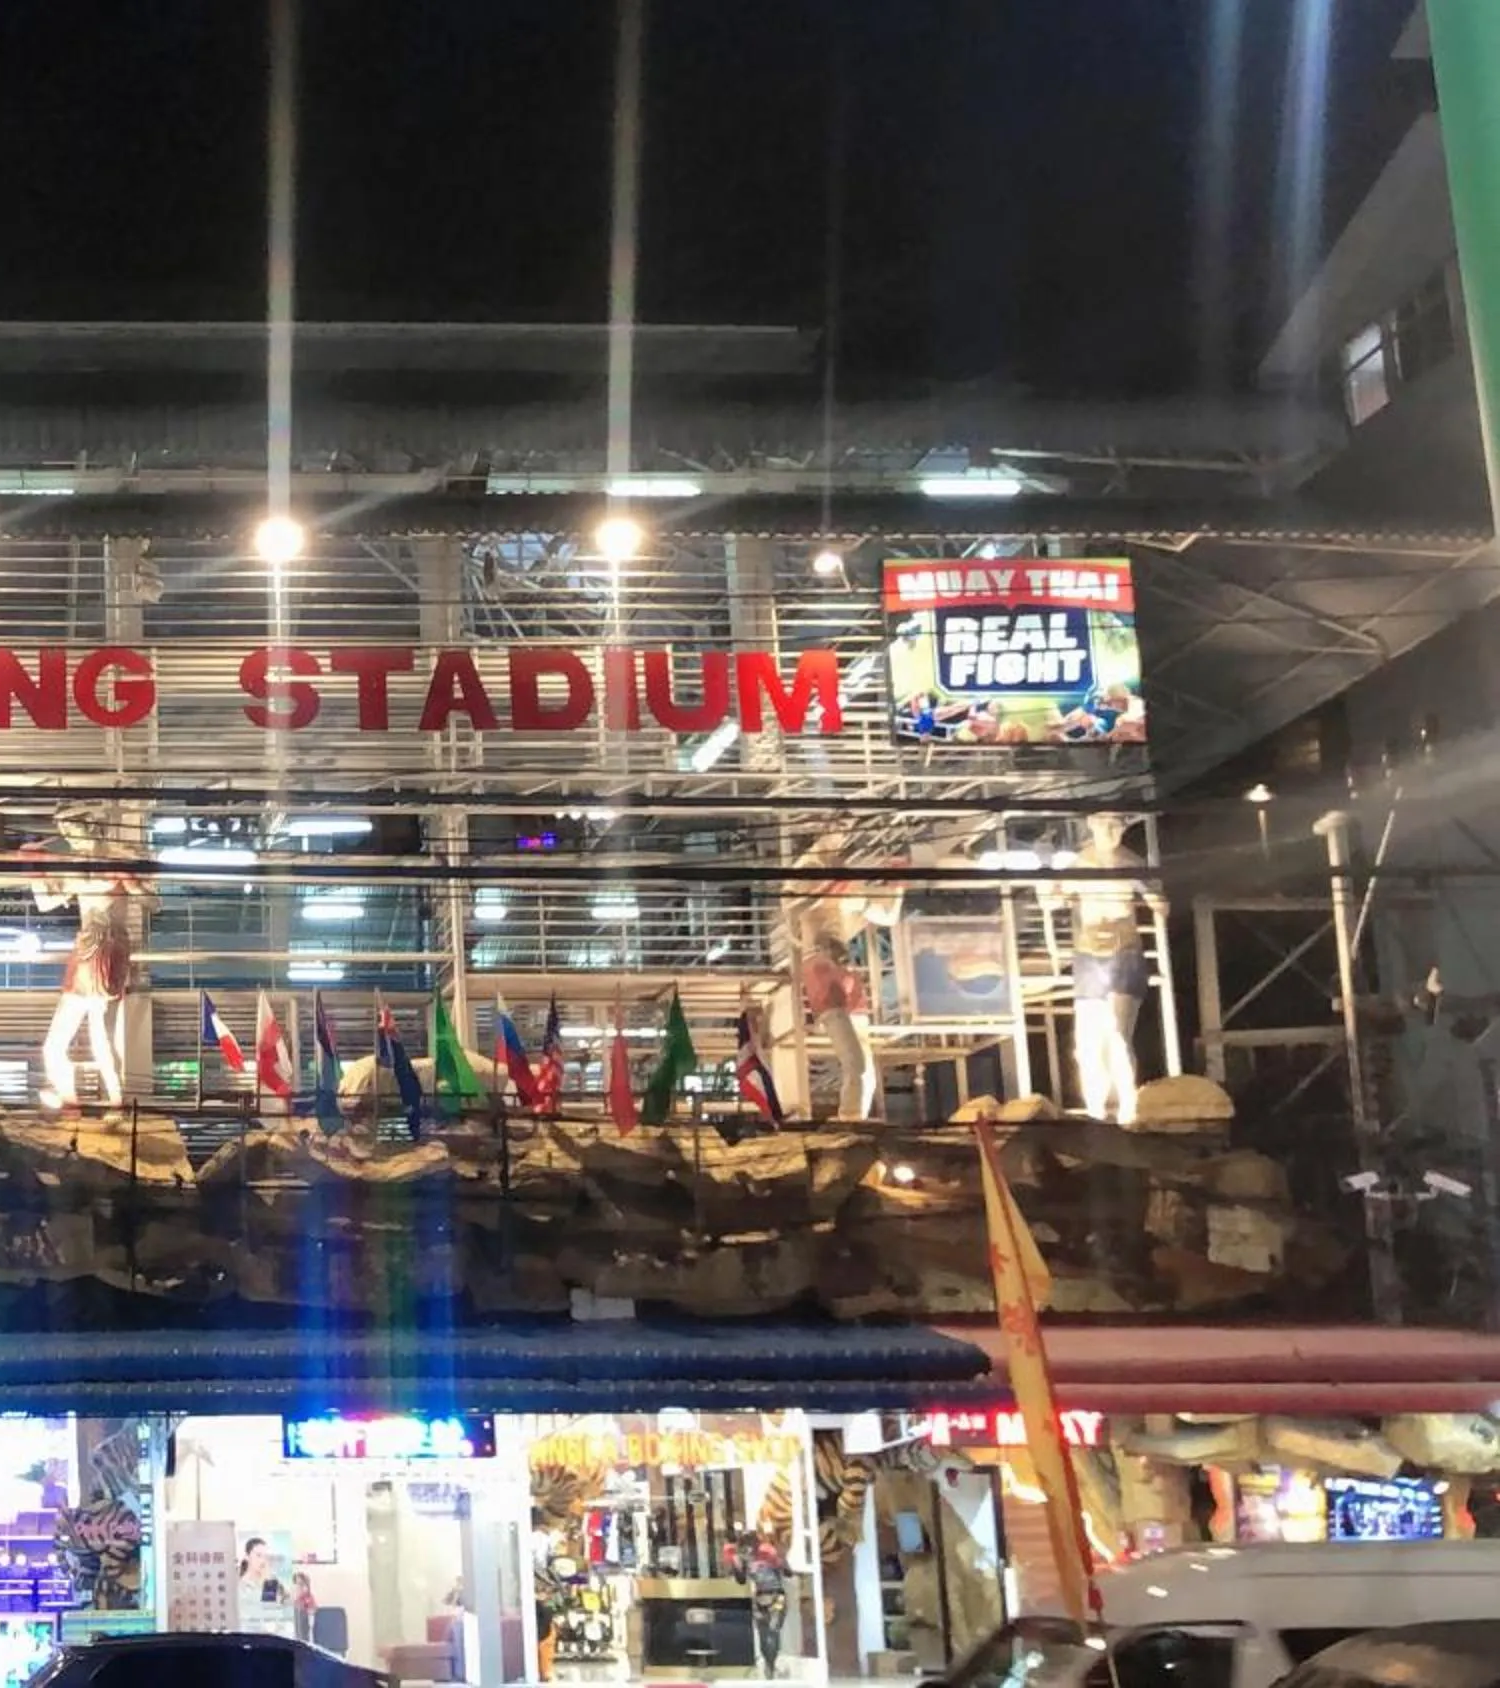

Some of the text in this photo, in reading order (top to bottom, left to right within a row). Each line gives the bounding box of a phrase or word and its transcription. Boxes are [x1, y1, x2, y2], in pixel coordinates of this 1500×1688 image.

[897, 569, 1119, 600] MUAY THAI
[943, 613, 1077, 653] REAL
[950, 649, 1087, 687] FIGHT
[239, 646, 842, 733] STADIUM
